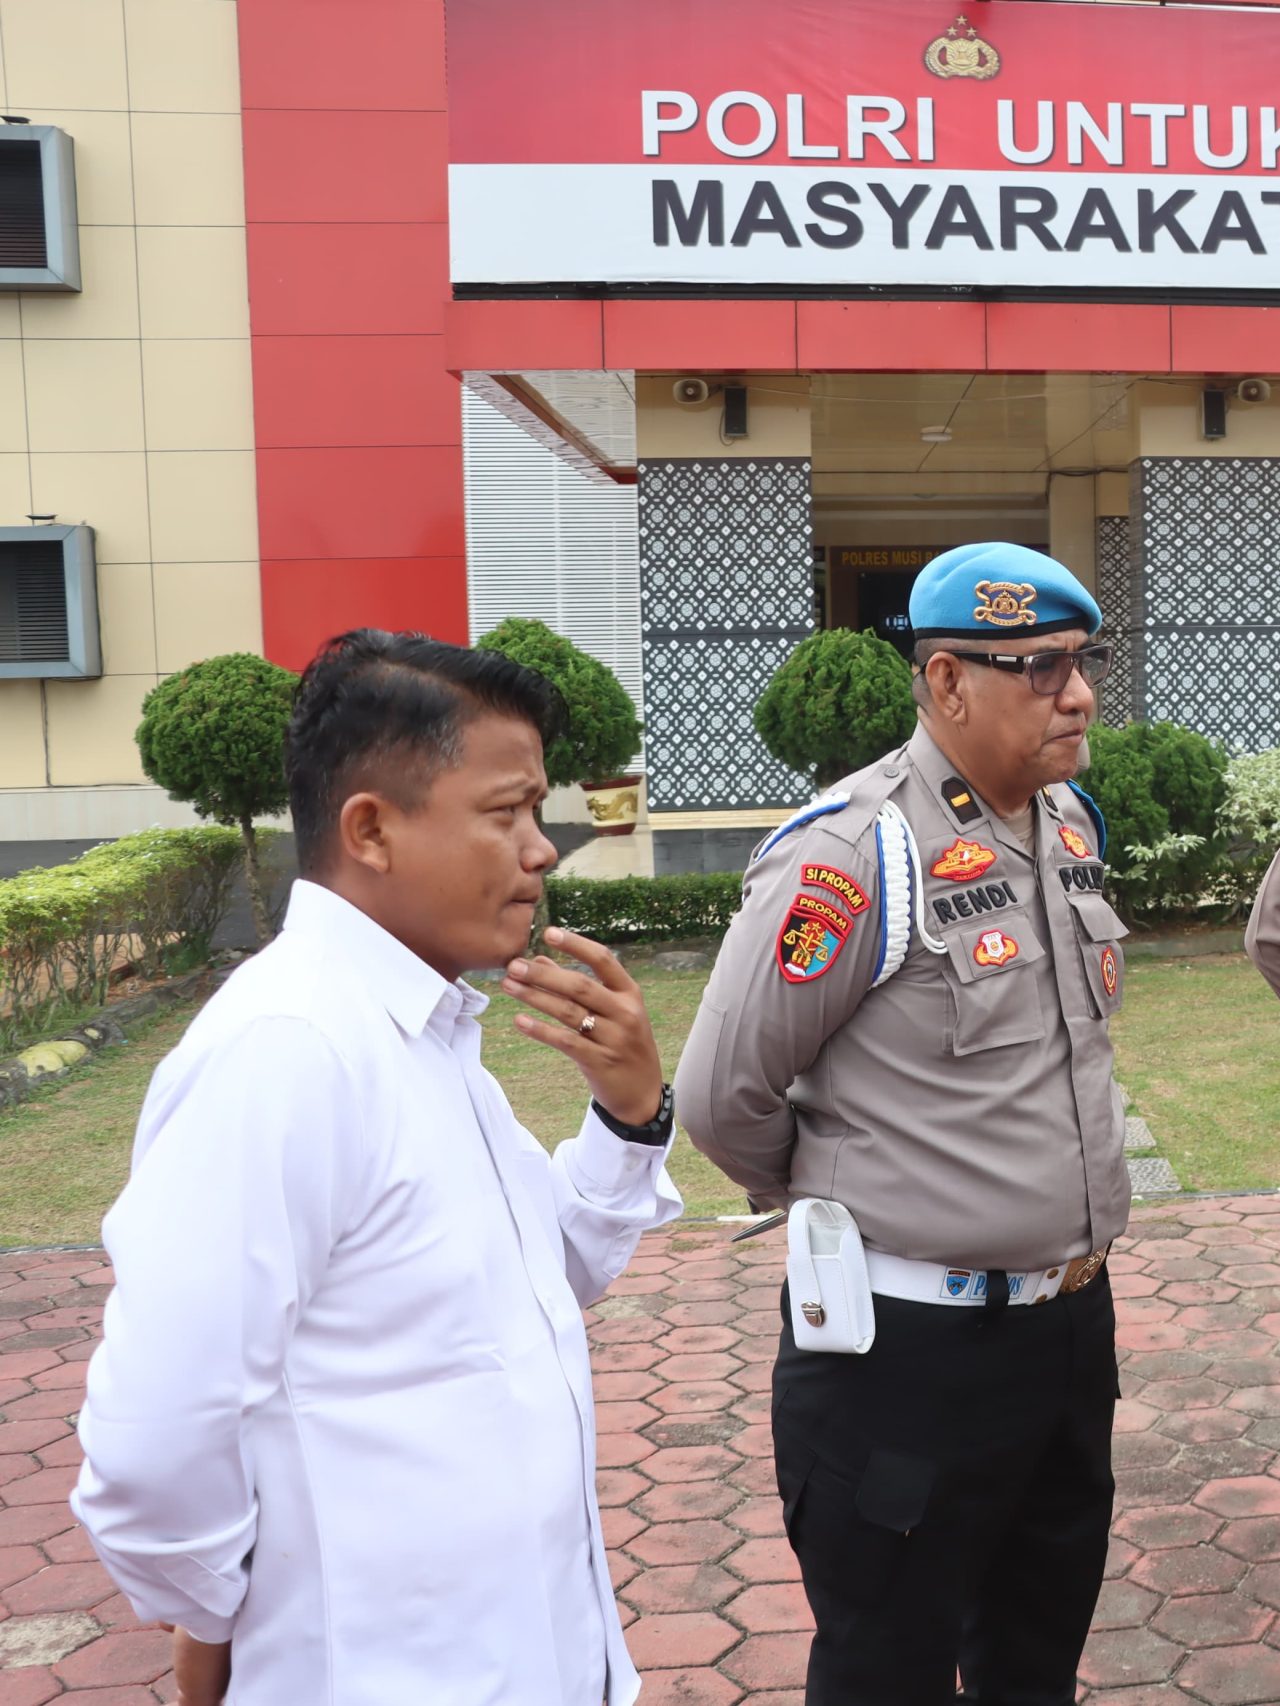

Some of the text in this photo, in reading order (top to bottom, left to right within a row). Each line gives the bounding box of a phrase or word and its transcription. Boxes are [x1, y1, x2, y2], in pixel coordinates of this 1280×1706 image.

[641, 90, 935, 162] POLRI
[841, 551, 889, 566] POLRES
[892, 551, 922, 565] MUSI
[806, 868, 863, 908] SI PROPAM
[932, 881, 1018, 924] RENDI
[799, 897, 847, 929] PROPAM
